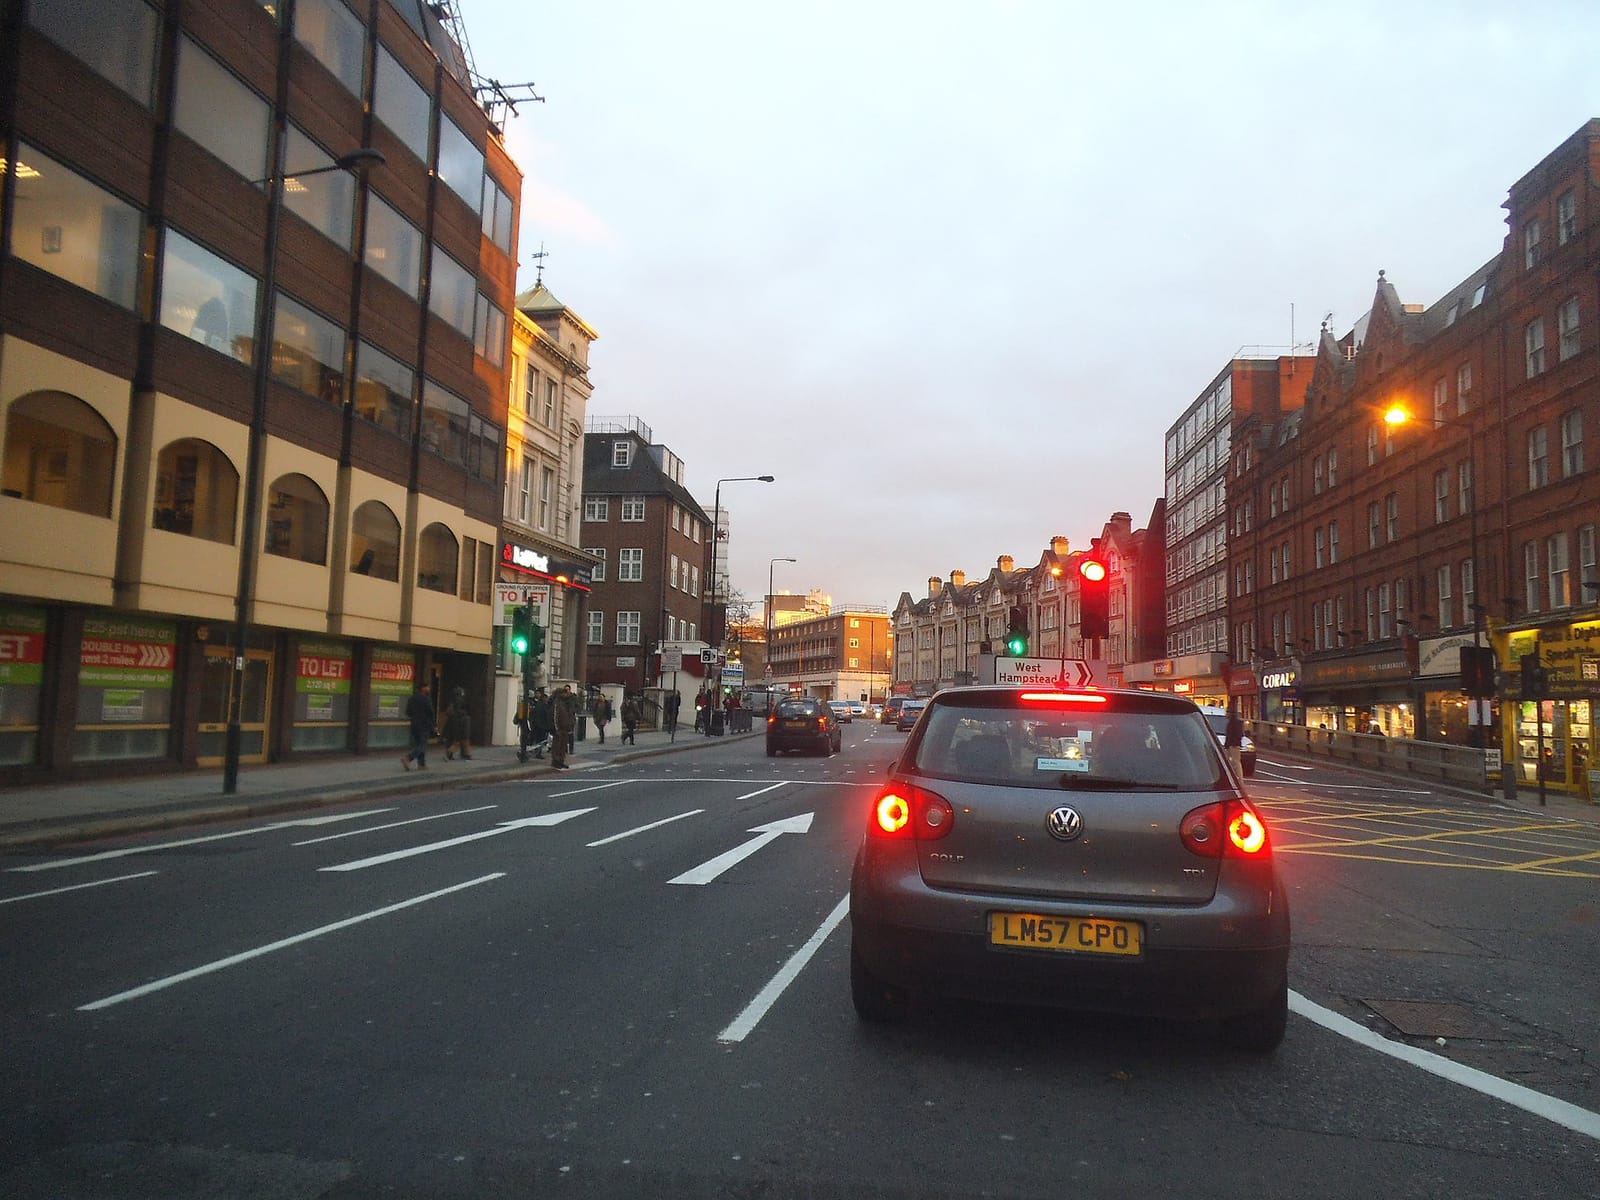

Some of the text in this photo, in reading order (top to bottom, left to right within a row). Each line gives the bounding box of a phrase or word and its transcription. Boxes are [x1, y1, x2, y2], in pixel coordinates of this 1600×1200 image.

[499, 591, 547, 603] TO LET
[81, 641, 121, 653] DOUBLE
[103, 655, 109, 664] 2
[301, 657, 346, 678] TO LET
[1015, 662, 1042, 672] West
[999, 672, 1058, 684] Hampstead
[1262, 672, 1291, 689] CORAL
[1003, 917, 1071, 944] LM57
